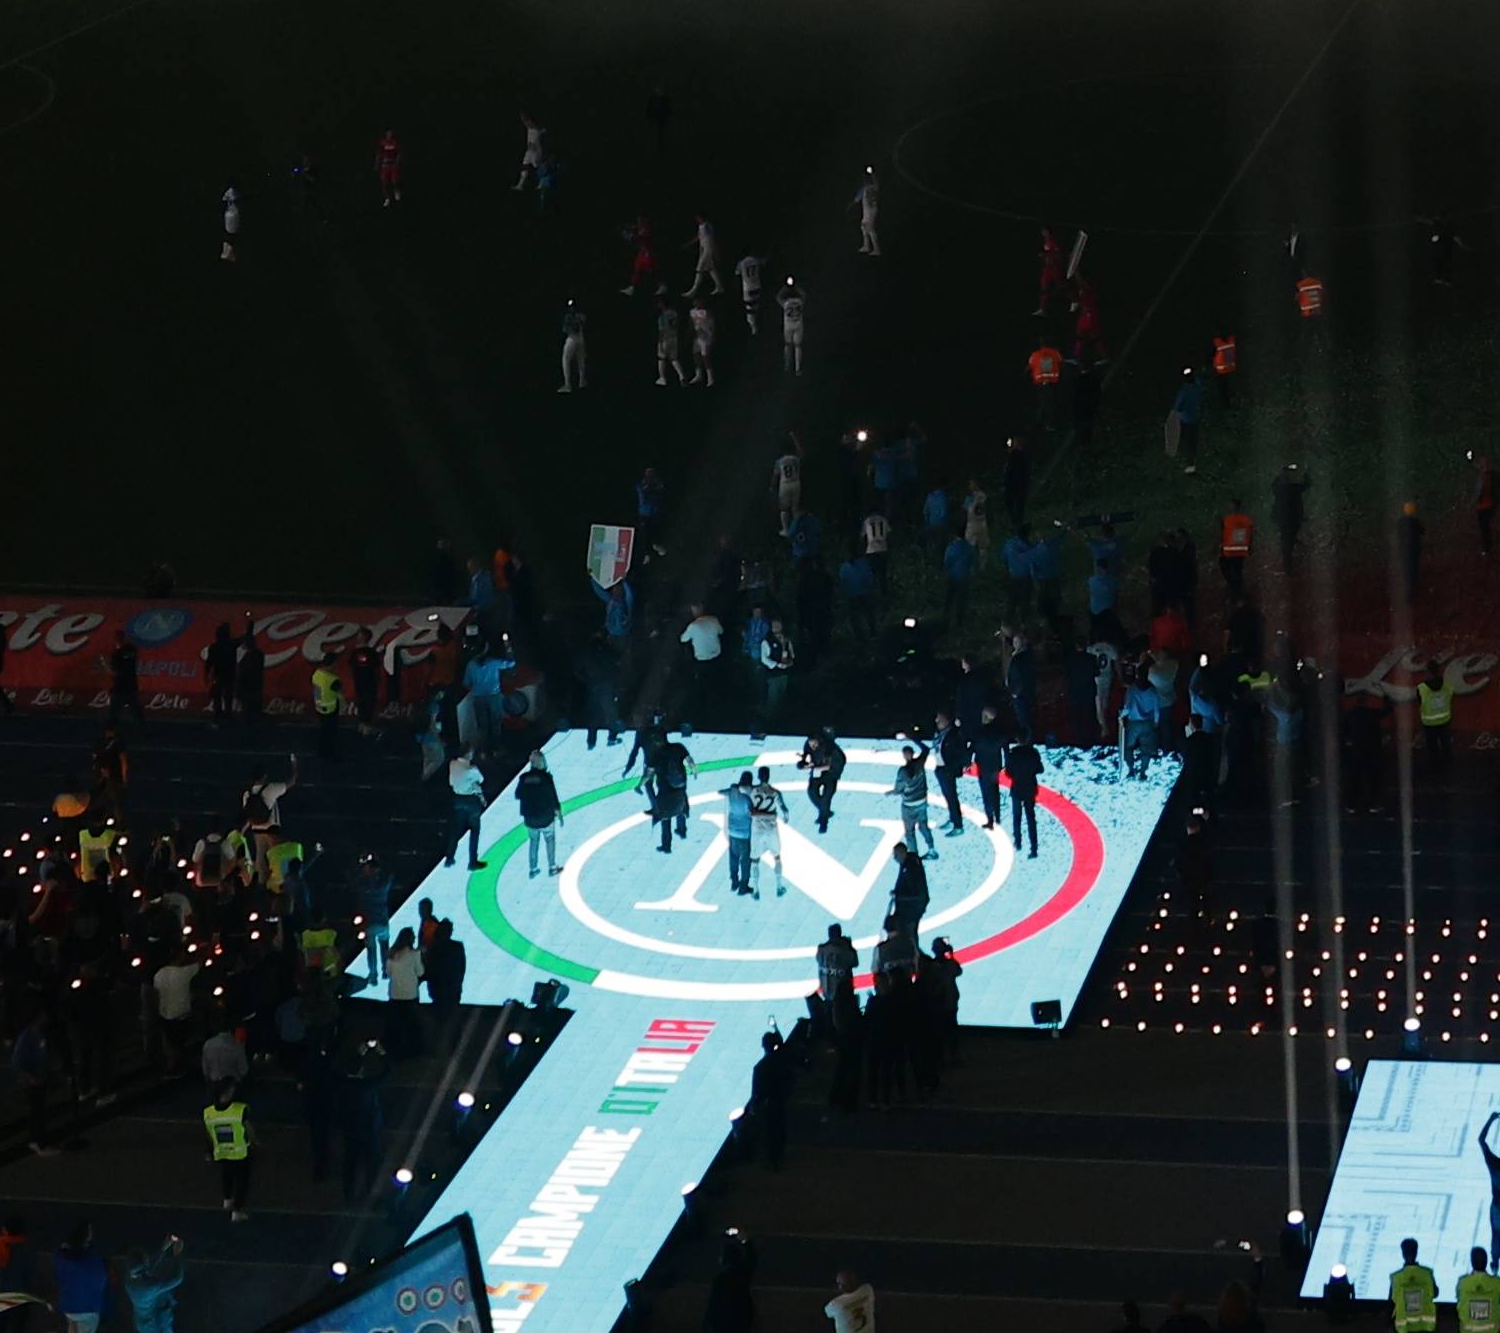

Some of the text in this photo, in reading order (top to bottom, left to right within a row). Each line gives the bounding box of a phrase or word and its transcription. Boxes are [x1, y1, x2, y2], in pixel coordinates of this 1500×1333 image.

[144, 693, 190, 710] Lete
[754, 793, 776, 814] 22
[488, 1126, 642, 1268] CAMPIONE
[597, 1019, 717, 1115] D'ITALIA
